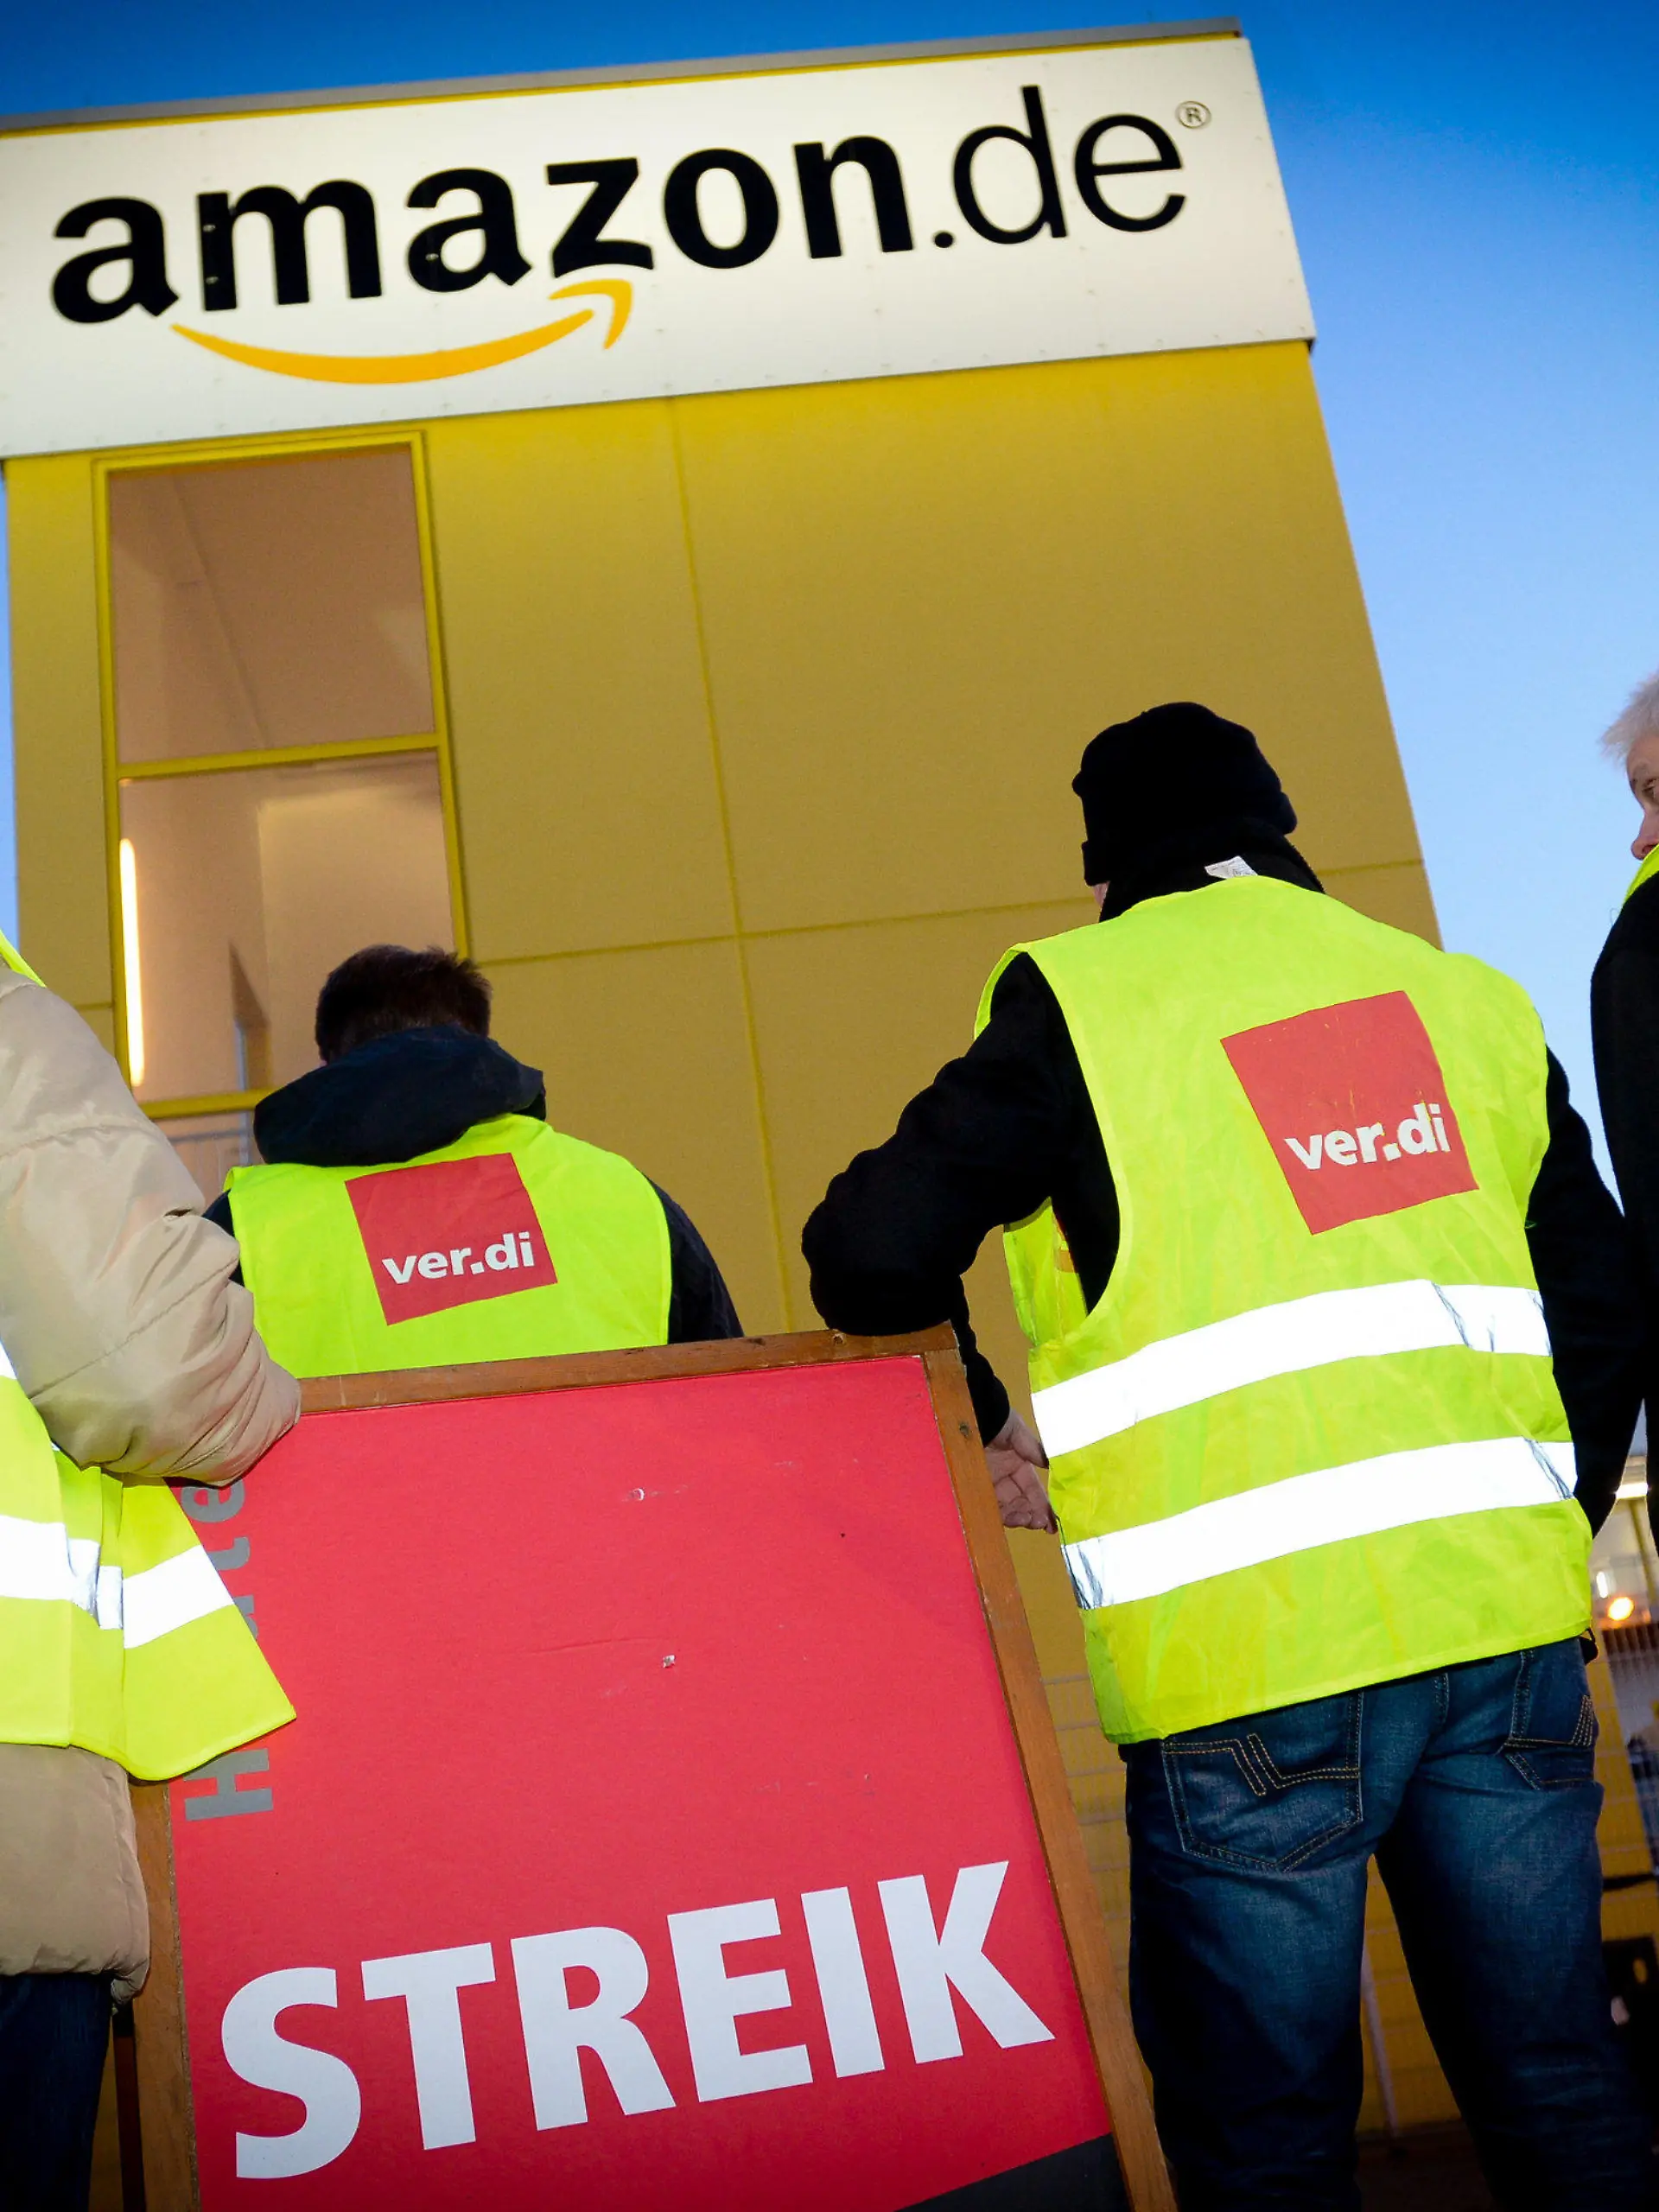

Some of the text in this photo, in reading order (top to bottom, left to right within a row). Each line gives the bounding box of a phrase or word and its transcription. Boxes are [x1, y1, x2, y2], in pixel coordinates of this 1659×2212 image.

[52, 86, 1185, 324] amazon.de
[1283, 1102, 1452, 1171] ver.di
[381, 1231, 535, 1285] ver.di
[221, 1860, 1056, 2179] STREIK
